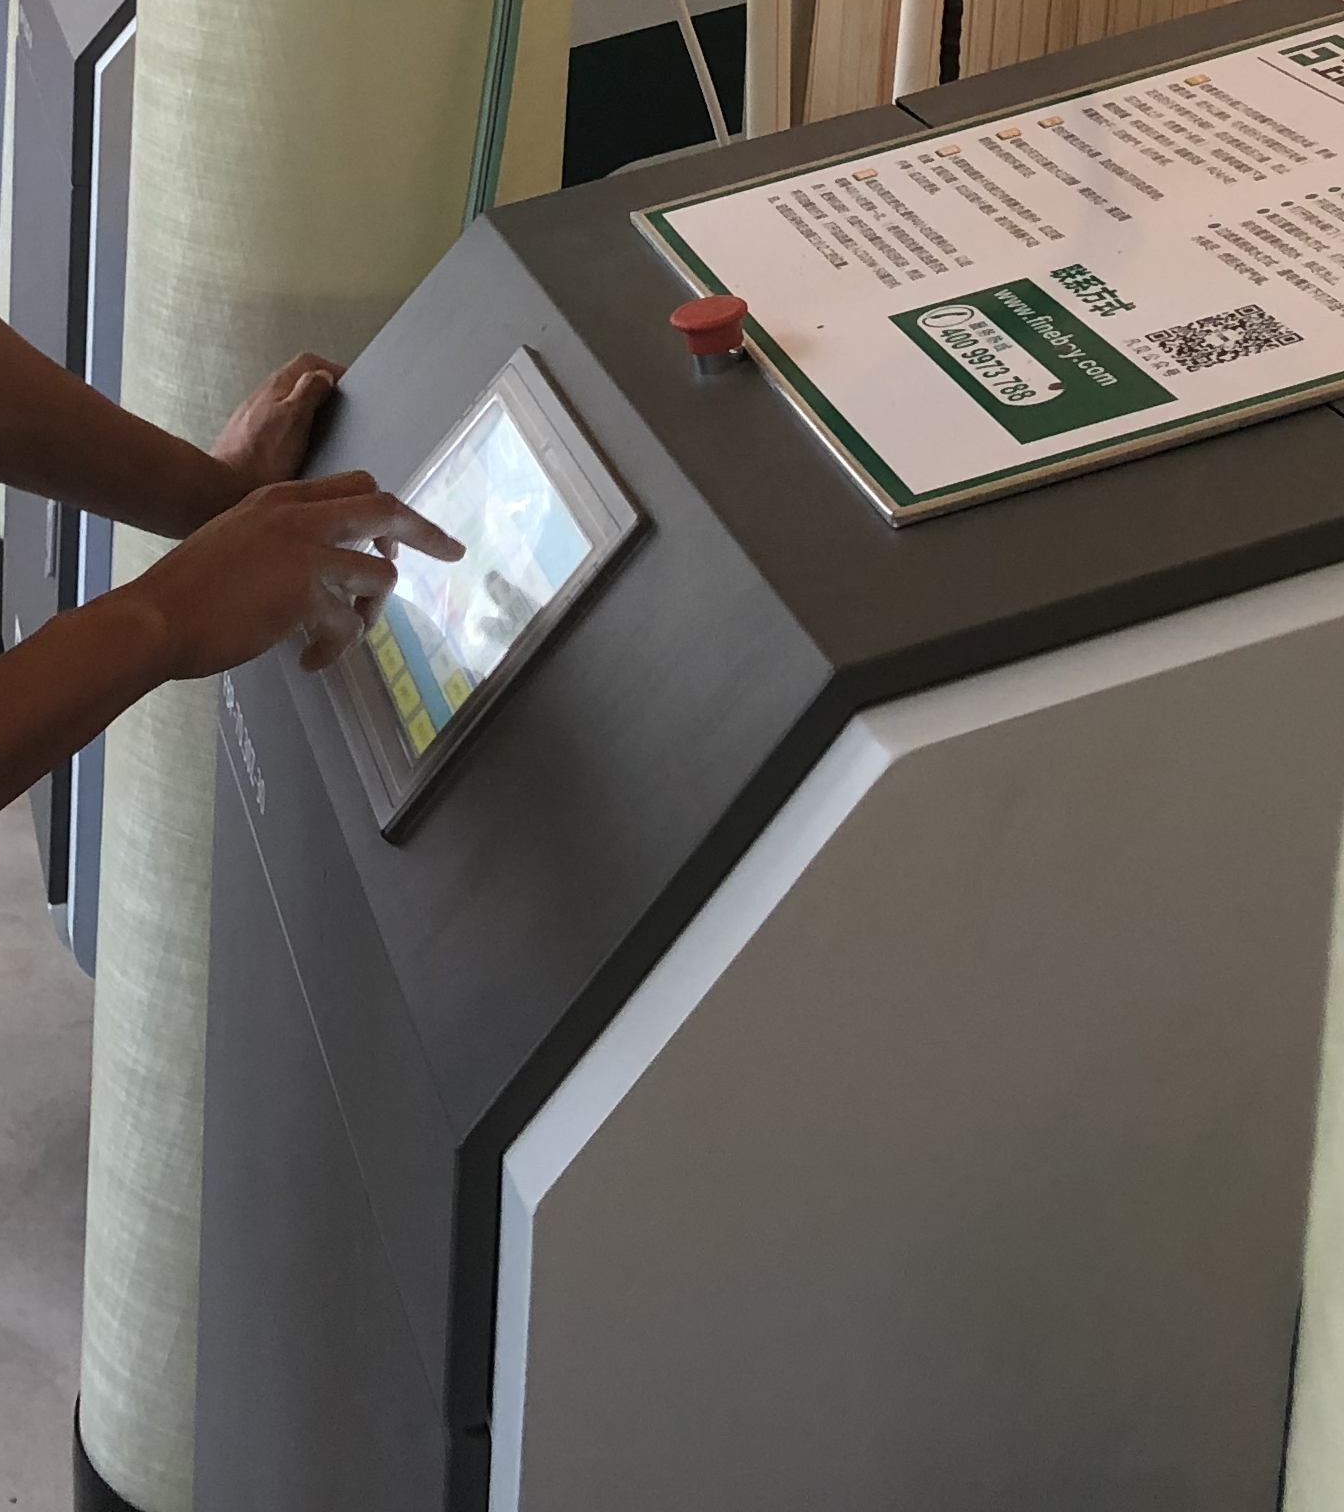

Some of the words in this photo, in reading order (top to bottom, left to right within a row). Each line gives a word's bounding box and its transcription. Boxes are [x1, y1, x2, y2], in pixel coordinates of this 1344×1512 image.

[1050, 263, 1136, 317] 联系方式
[940, 329, 979, 350] 400
[961, 348, 1010, 378] 9973
[993, 376, 1037, 402] 788
